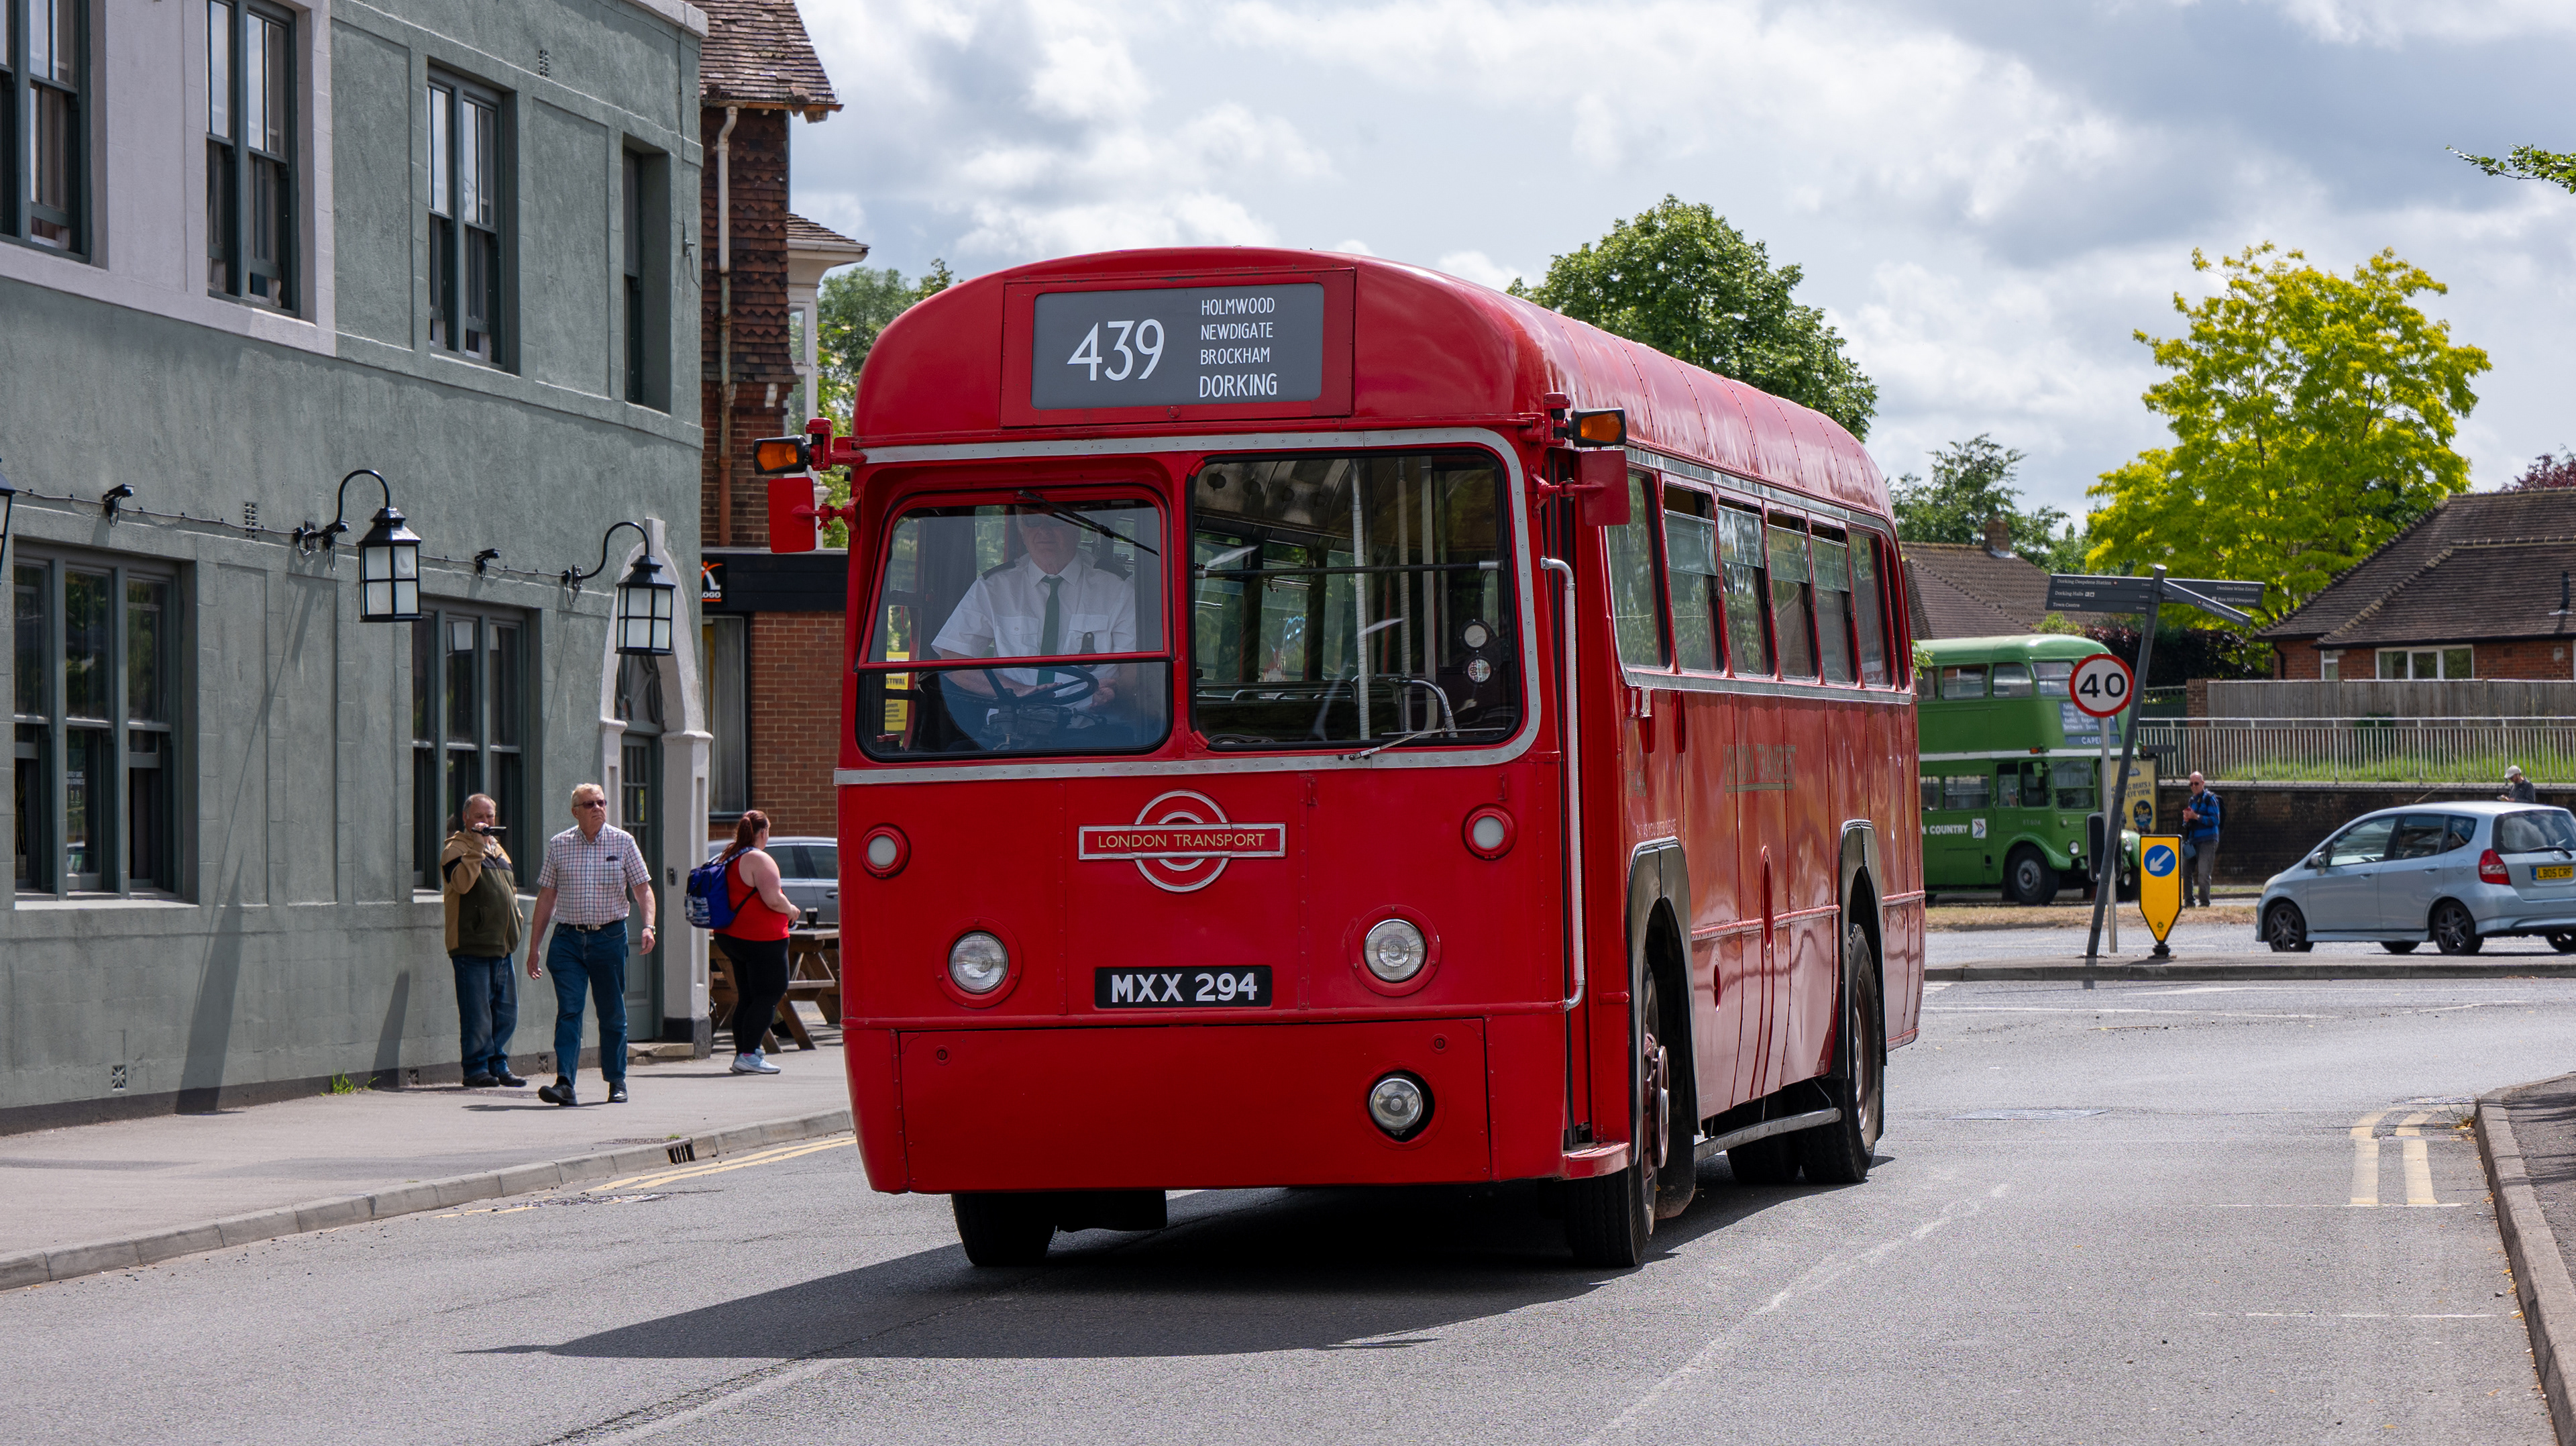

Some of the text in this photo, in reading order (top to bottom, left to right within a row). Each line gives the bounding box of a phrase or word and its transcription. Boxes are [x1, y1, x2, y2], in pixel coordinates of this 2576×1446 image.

[1201, 297, 1275, 316] HOLMWOOD
[1201, 322, 1273, 341] NEWDIGATE
[1067, 319, 1165, 381] 439
[1200, 347, 1271, 365] BROCKHAM
[1199, 373, 1277, 398] DORKING
[2202, 602, 2244, 622] Dorking (Main) Station
[2079, 672, 2125, 698] 40
[2133, 782, 2147, 790] BEATS
[1929, 824, 1969, 835] COUNTRY
[1098, 833, 1265, 848] LONDON TRANSPORT
[2537, 868, 2573, 878] LB05 CRF
[1111, 972, 1258, 1003] MXX 294
